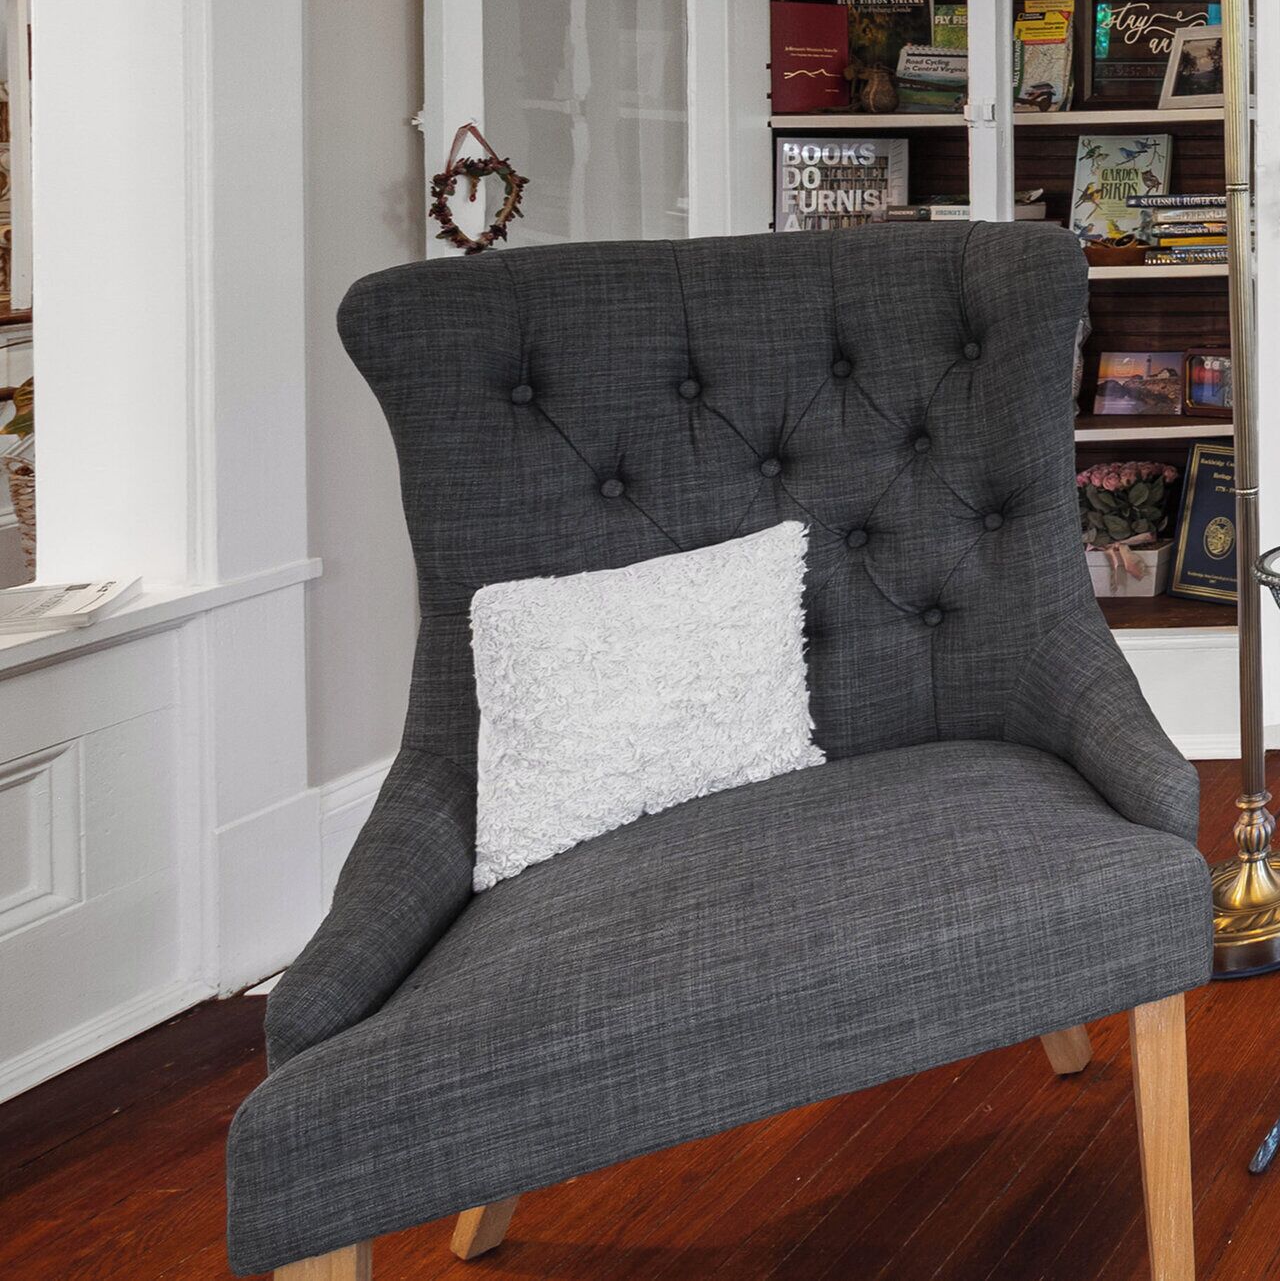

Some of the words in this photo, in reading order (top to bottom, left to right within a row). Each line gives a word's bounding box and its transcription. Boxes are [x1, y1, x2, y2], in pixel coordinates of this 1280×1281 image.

[934, 15, 951, 24] FLY
[925, 59, 950, 67] Cycling
[940, 66, 966, 74] Virginia
[782, 142, 876, 166] BOOKS
[783, 166, 822, 189] DO
[1101, 168, 1139, 183] GARDEN
[1100, 182, 1139, 201] BIRDS
[782, 189, 899, 214] FURNISH
[1140, 197, 1181, 207] SUCCESSFUL
[1183, 196, 1210, 206] FLOWER
[783, 214, 801, 231] A
